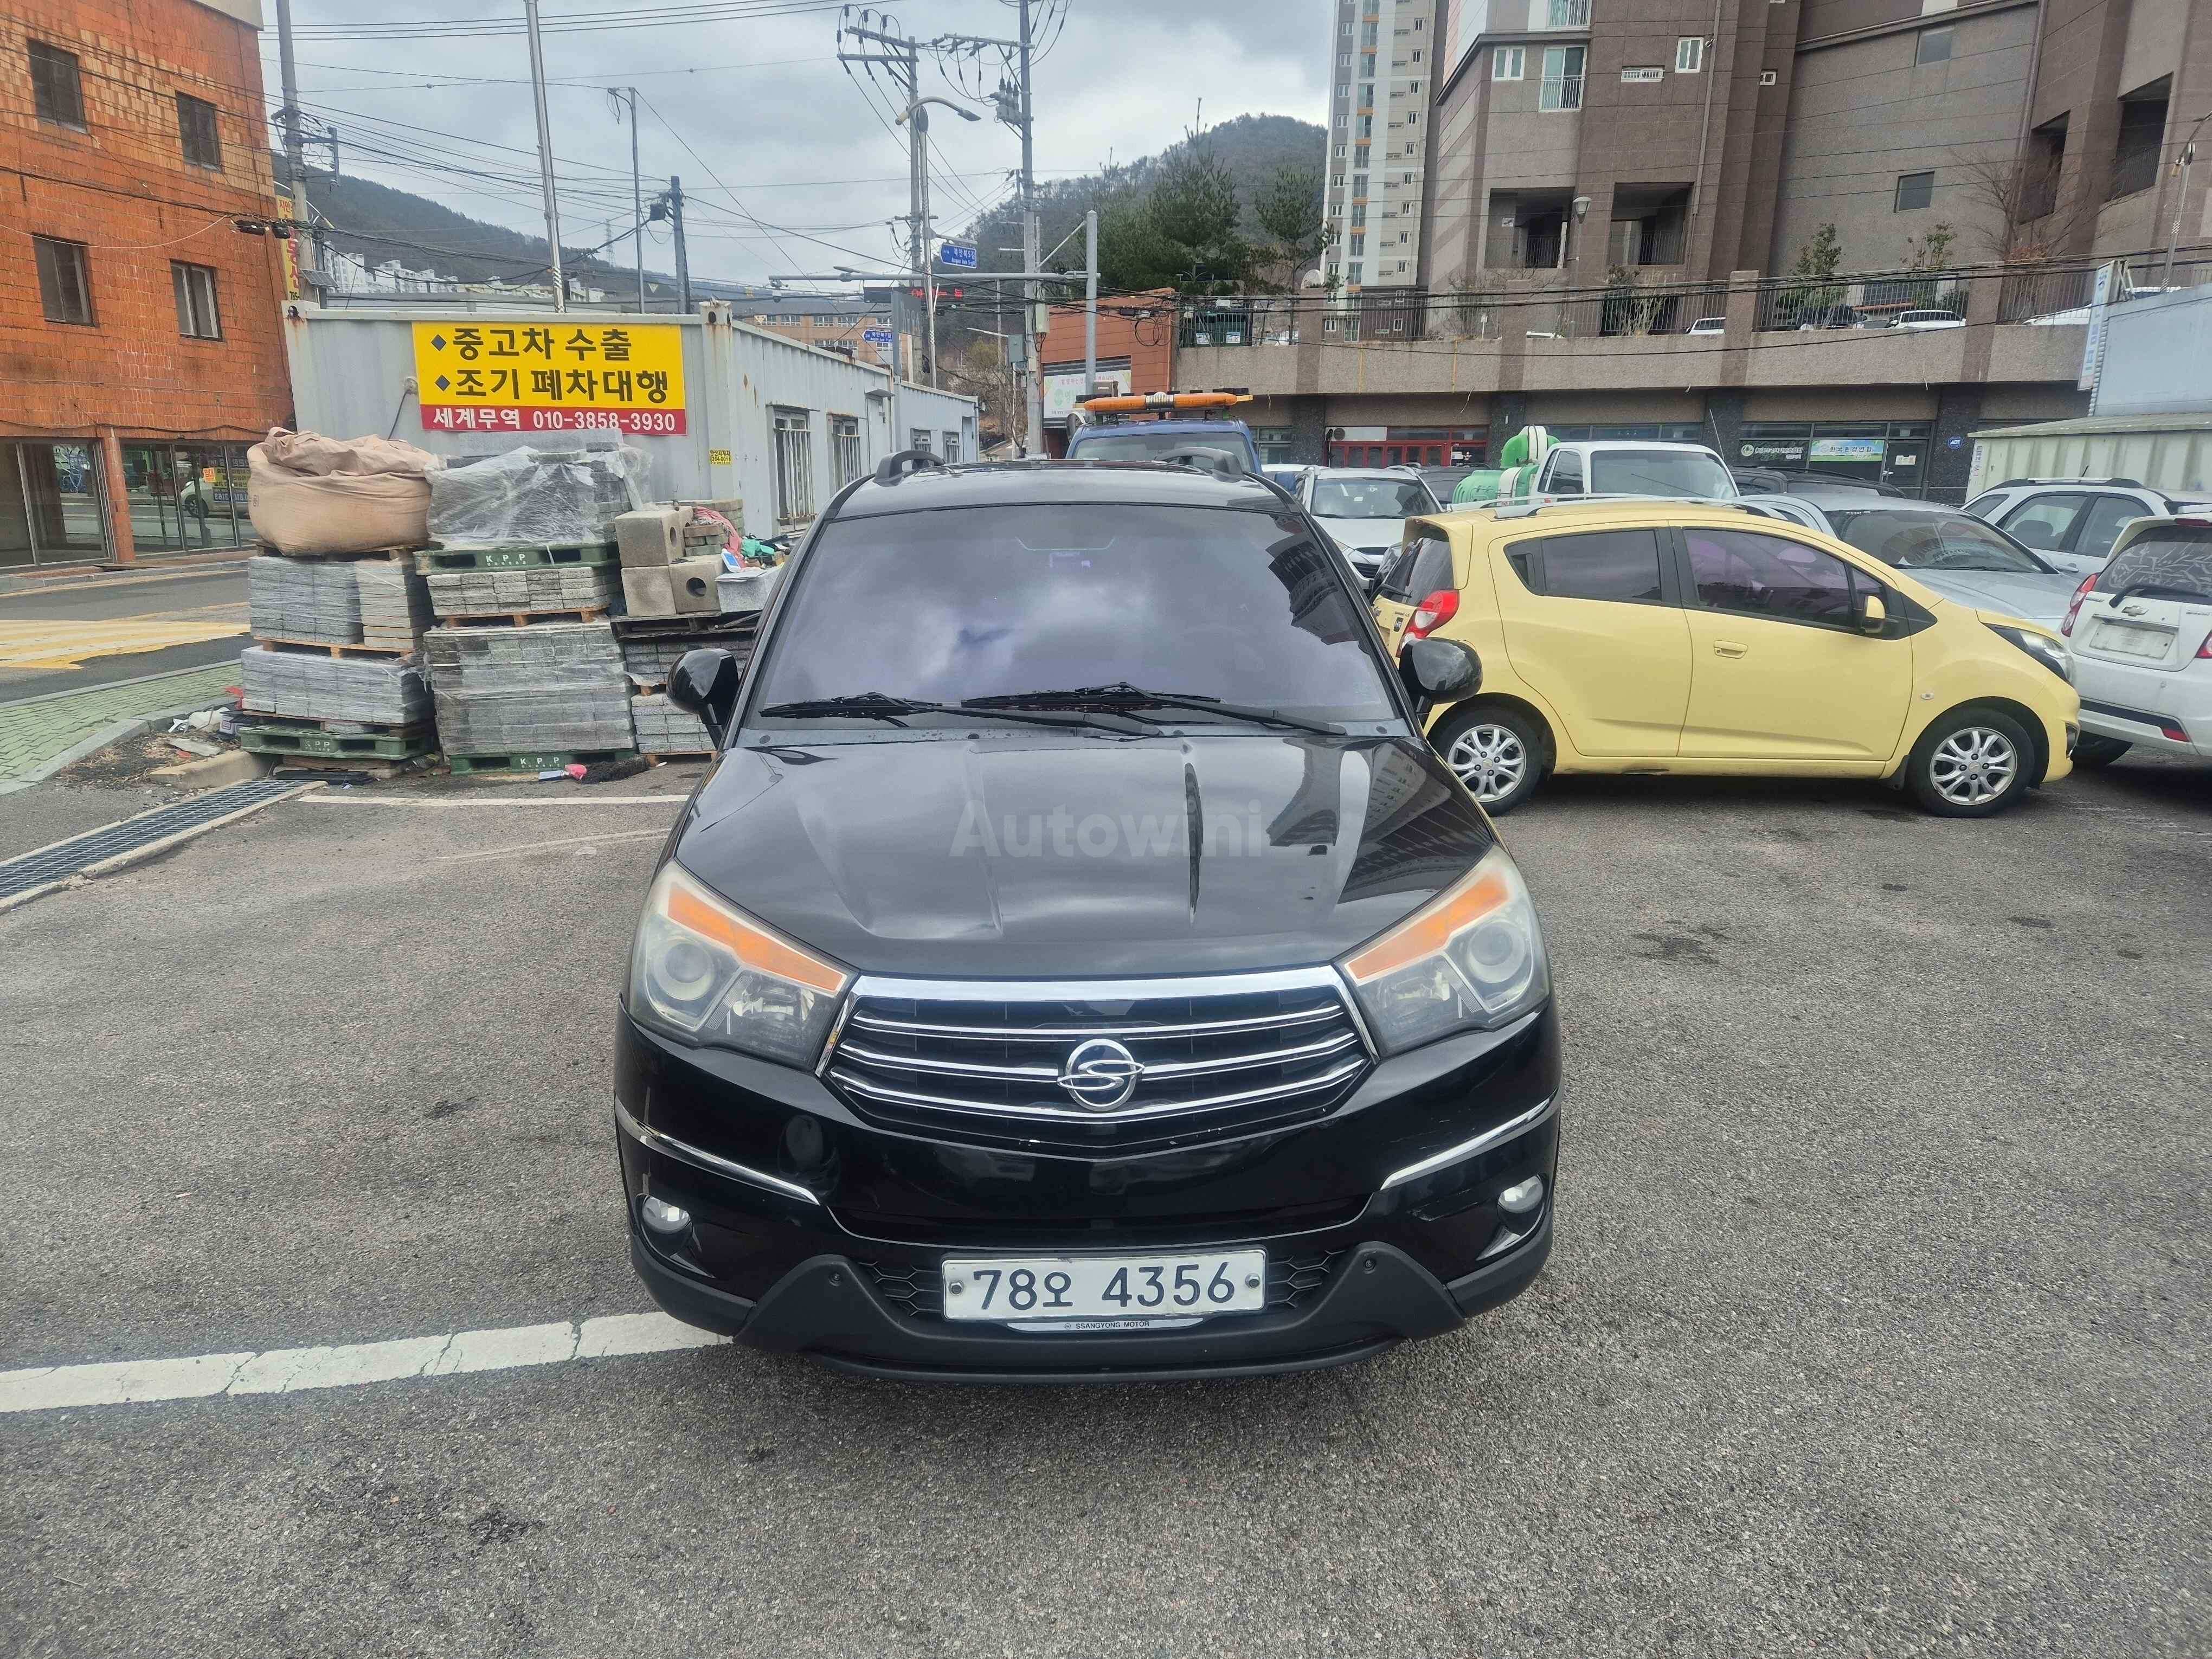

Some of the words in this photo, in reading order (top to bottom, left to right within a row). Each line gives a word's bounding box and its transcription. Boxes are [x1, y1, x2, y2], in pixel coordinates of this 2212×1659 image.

[452, 327, 555, 361] 중고차
[565, 329, 632, 361] 수출
[455, 369, 519, 400] 조기
[531, 369, 668, 403] 폐차대행
[433, 408, 520, 429] 세계무역
[533, 410, 676, 432] 010-3858-3930
[973, 1268, 1073, 1310] 78오
[1101, 1262, 1235, 1308] 4356
